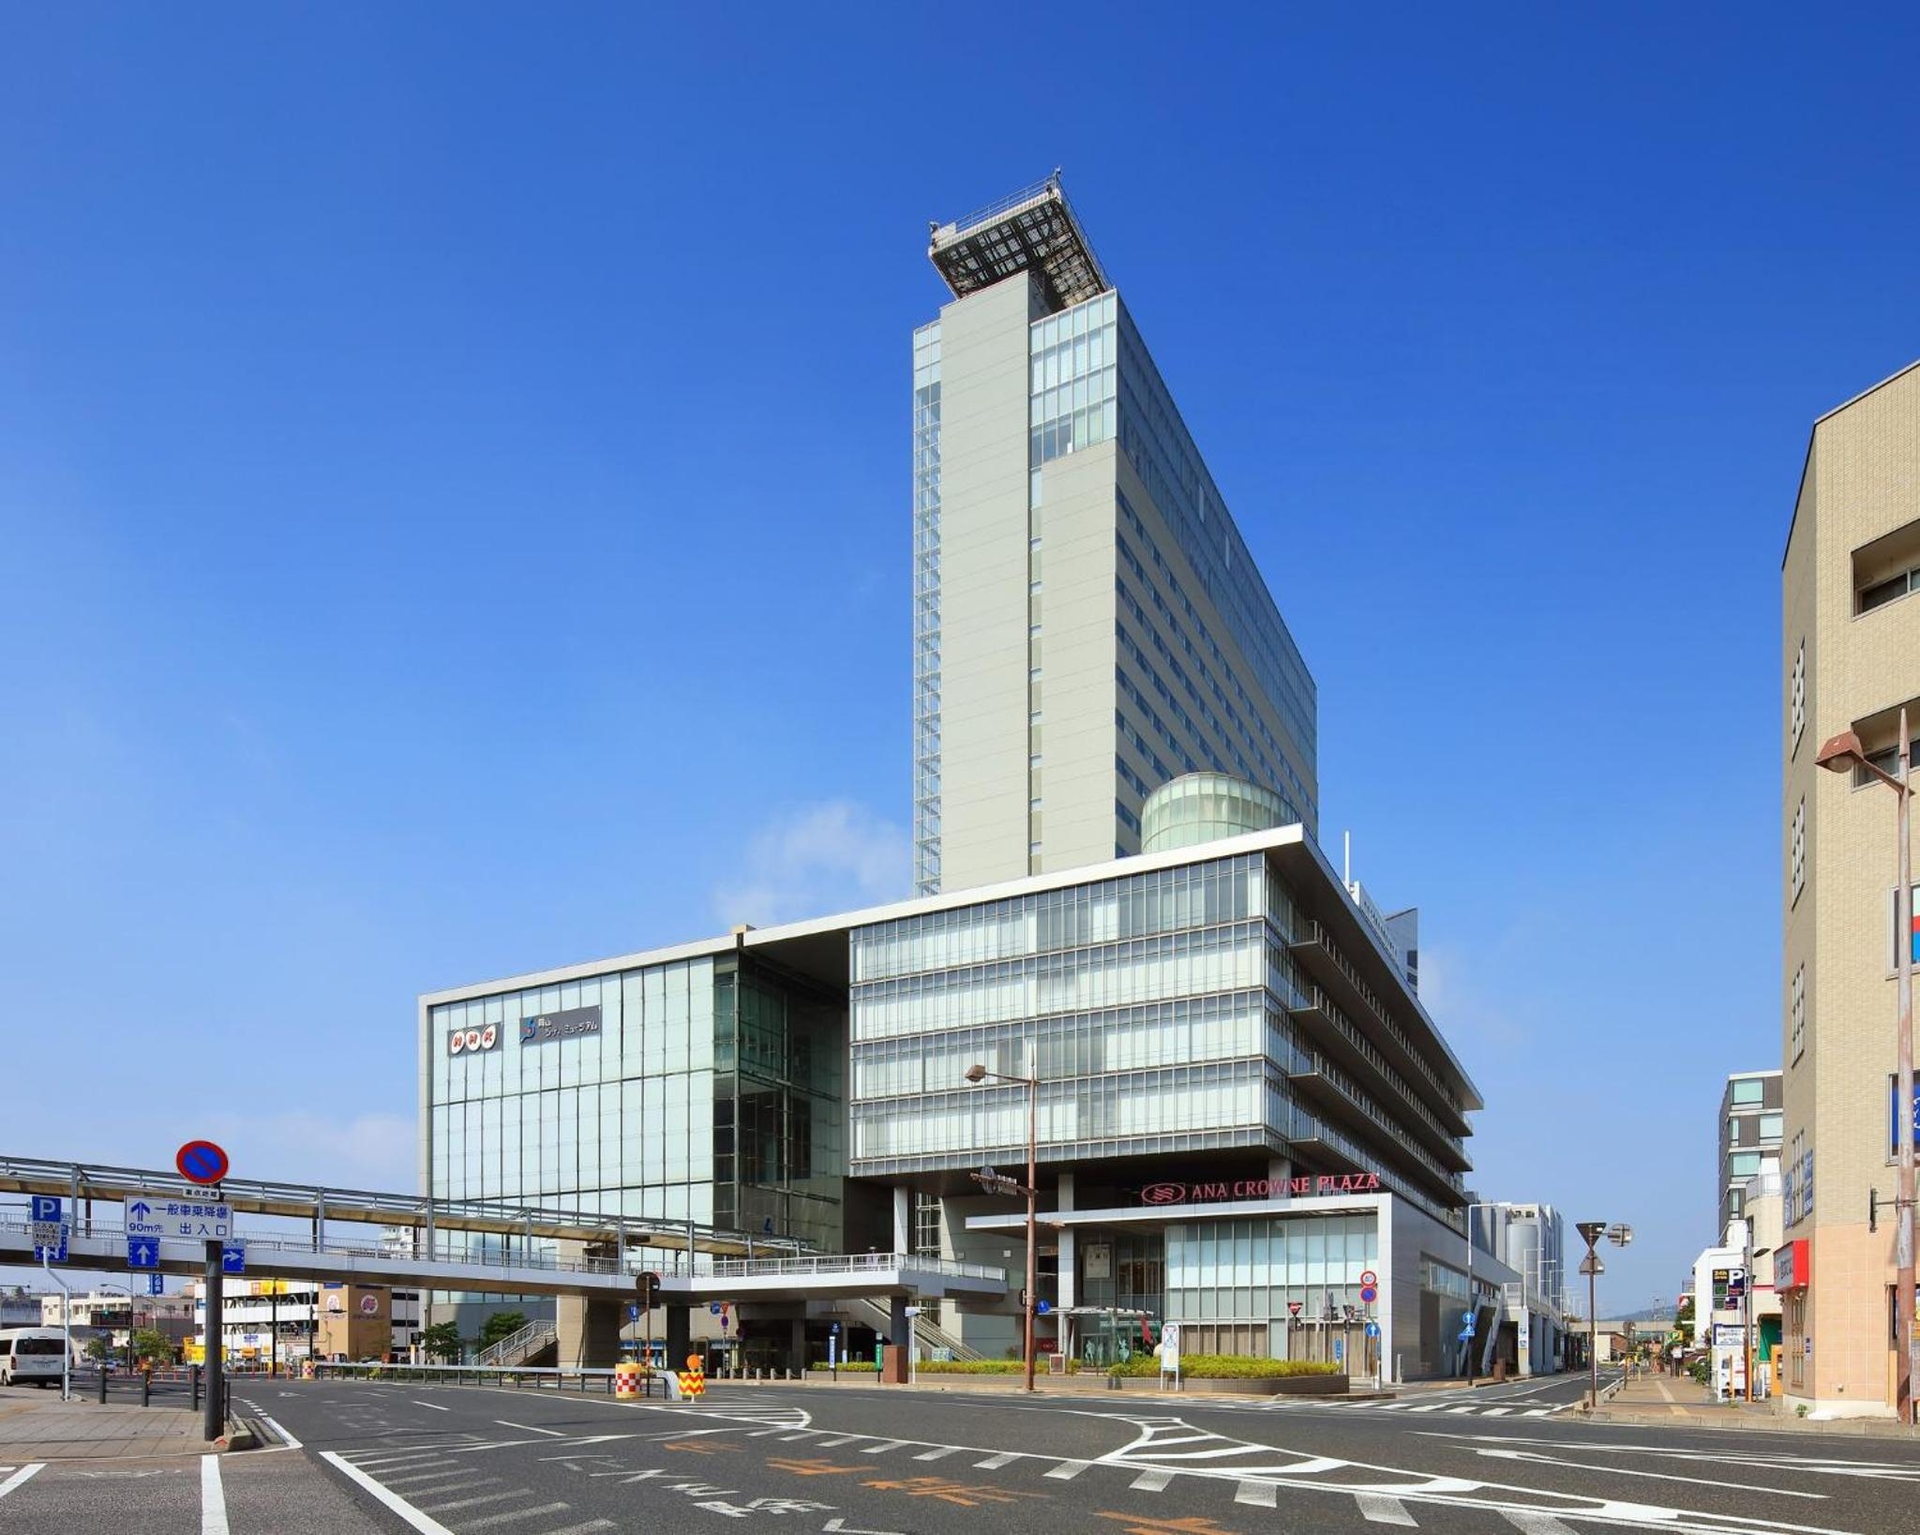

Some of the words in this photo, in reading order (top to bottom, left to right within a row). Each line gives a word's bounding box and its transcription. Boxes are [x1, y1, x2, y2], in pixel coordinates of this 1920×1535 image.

[1192, 1183, 1228, 1199] ANA
[1234, 1177, 1310, 1197] CROWNE
[1317, 1173, 1380, 1191] PLAZA
[40, 1199, 56, 1219] P
[155, 1203, 228, 1219] 一般車乗降場
[128, 1222, 164, 1233] 90m先
[180, 1223, 227, 1236] 出入口
[1728, 1269, 1744, 1285] P
